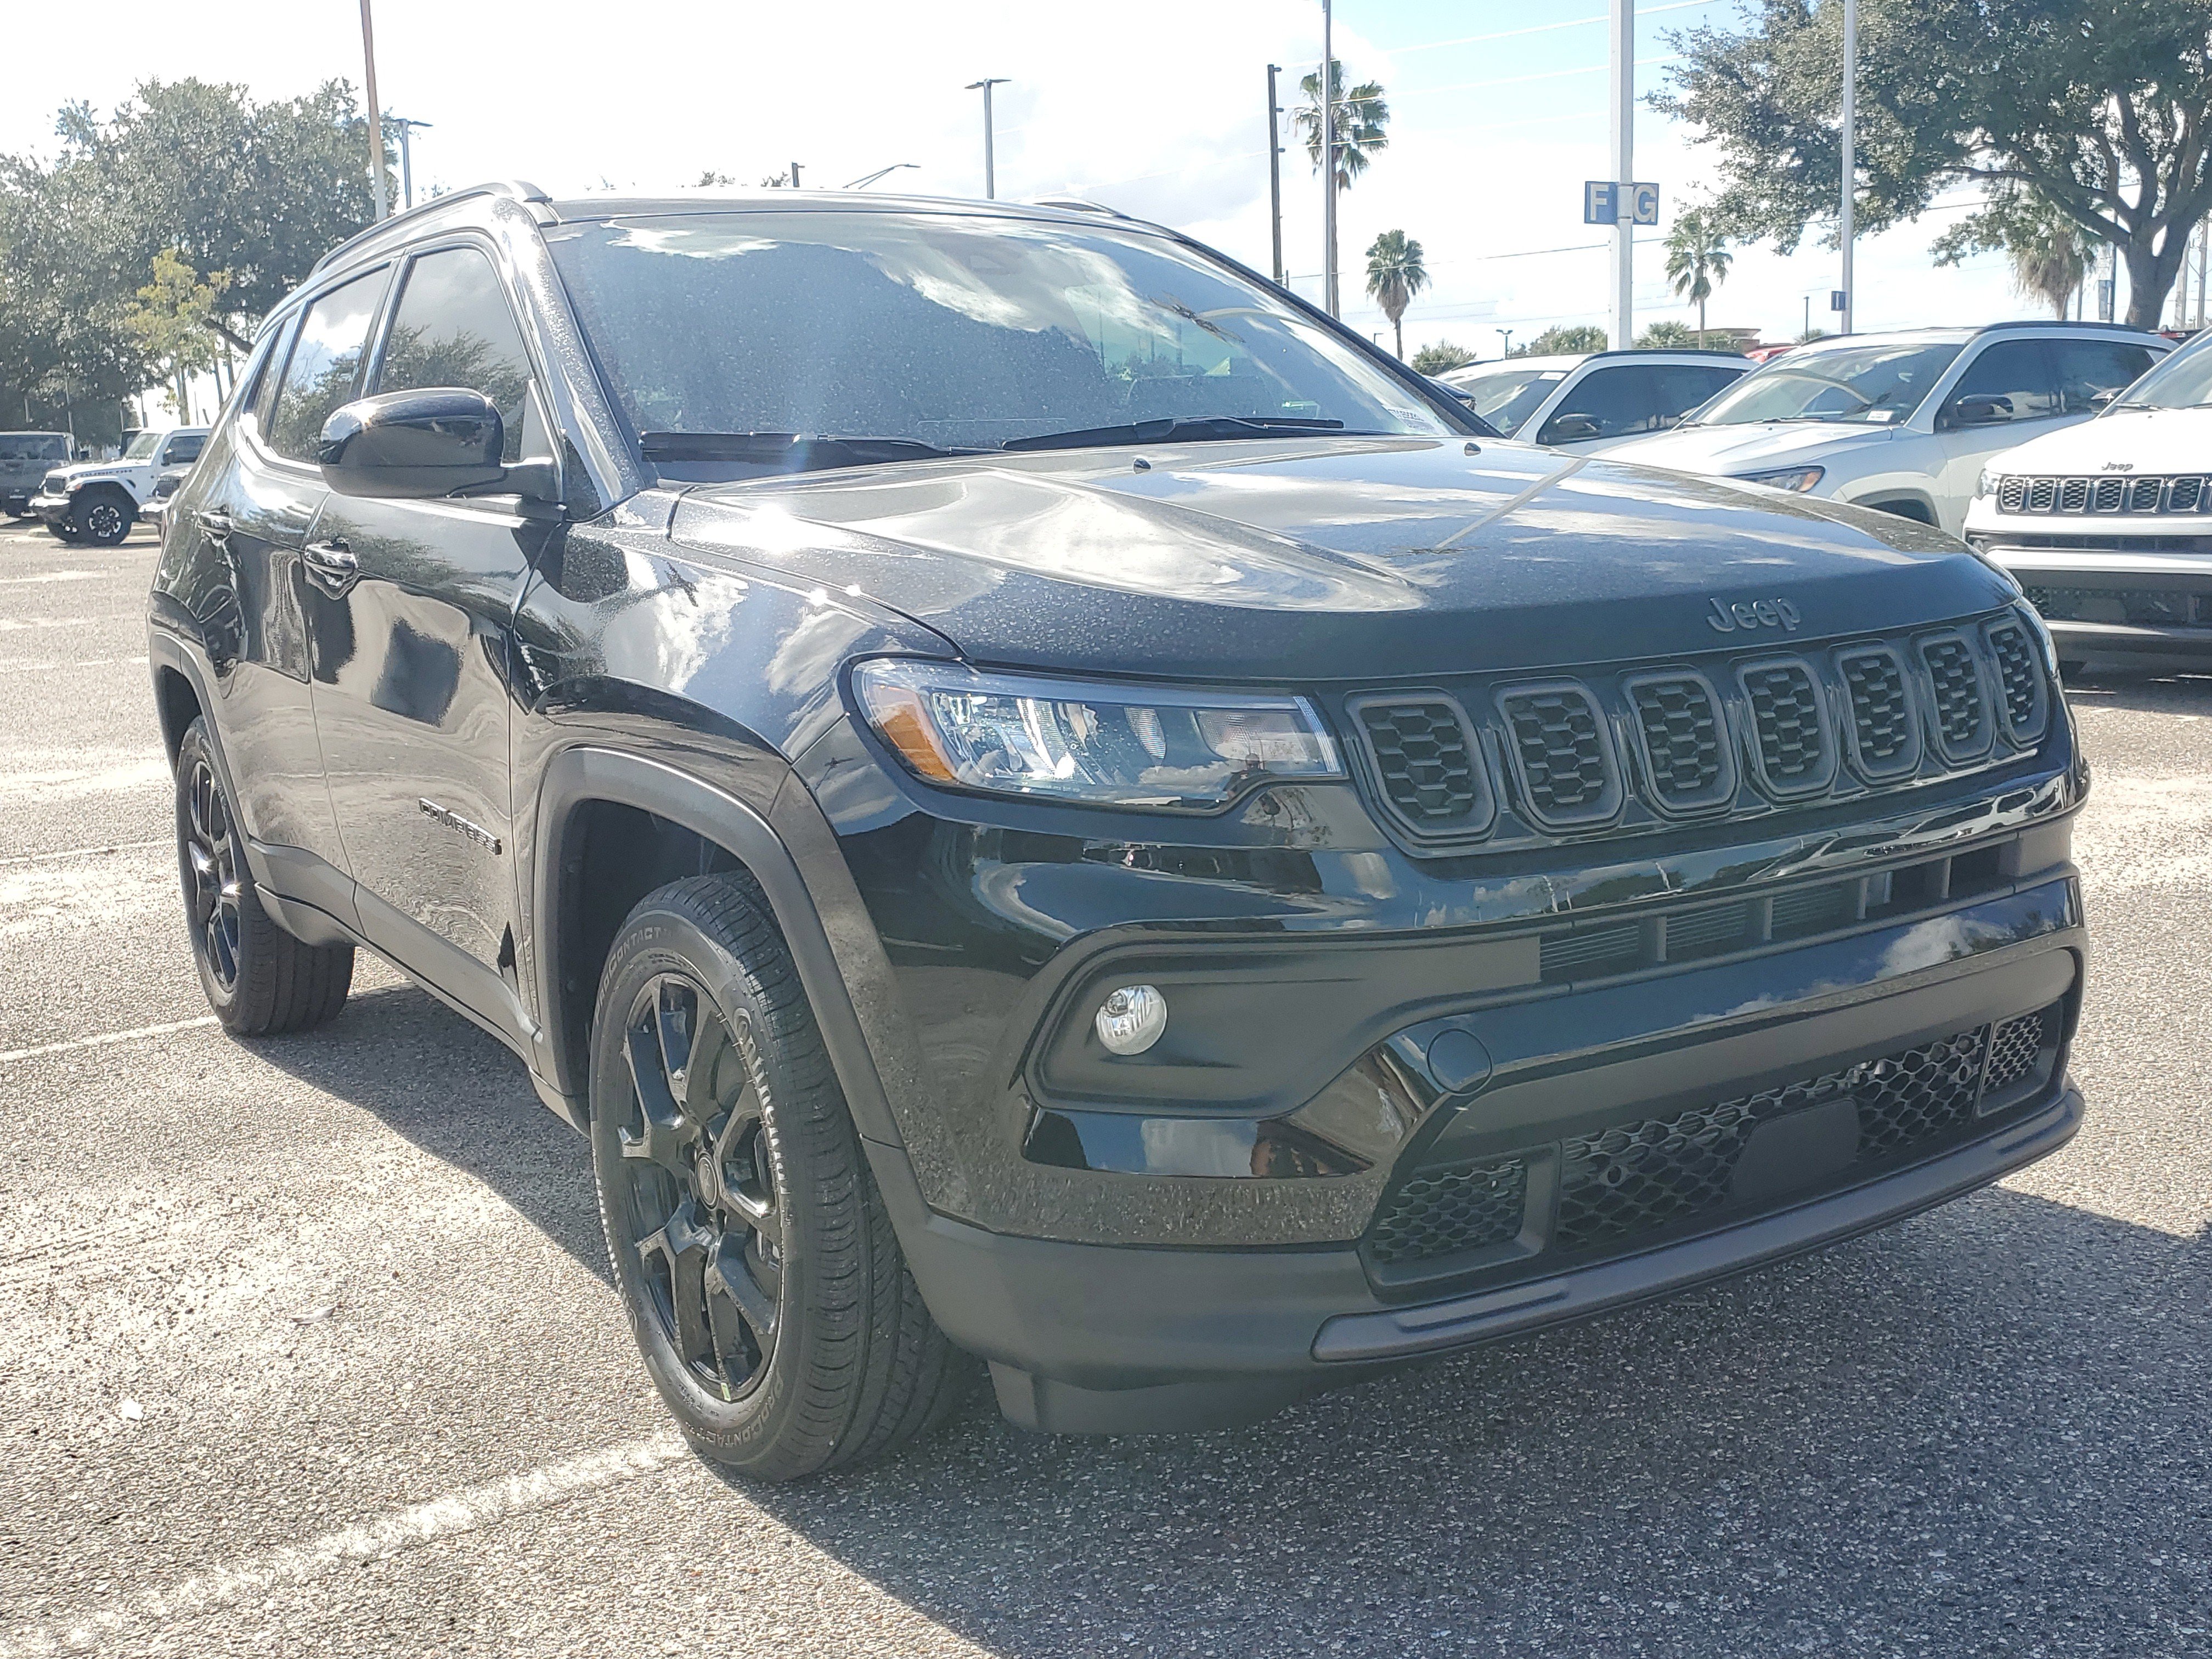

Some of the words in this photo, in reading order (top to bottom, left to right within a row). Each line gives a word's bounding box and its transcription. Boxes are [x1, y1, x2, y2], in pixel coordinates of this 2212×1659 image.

[1590, 184, 1609, 221] F
[1632, 185, 1656, 223] G
[2101, 461, 2134, 472] Jeep
[1707, 597, 1801, 633] Jeep
